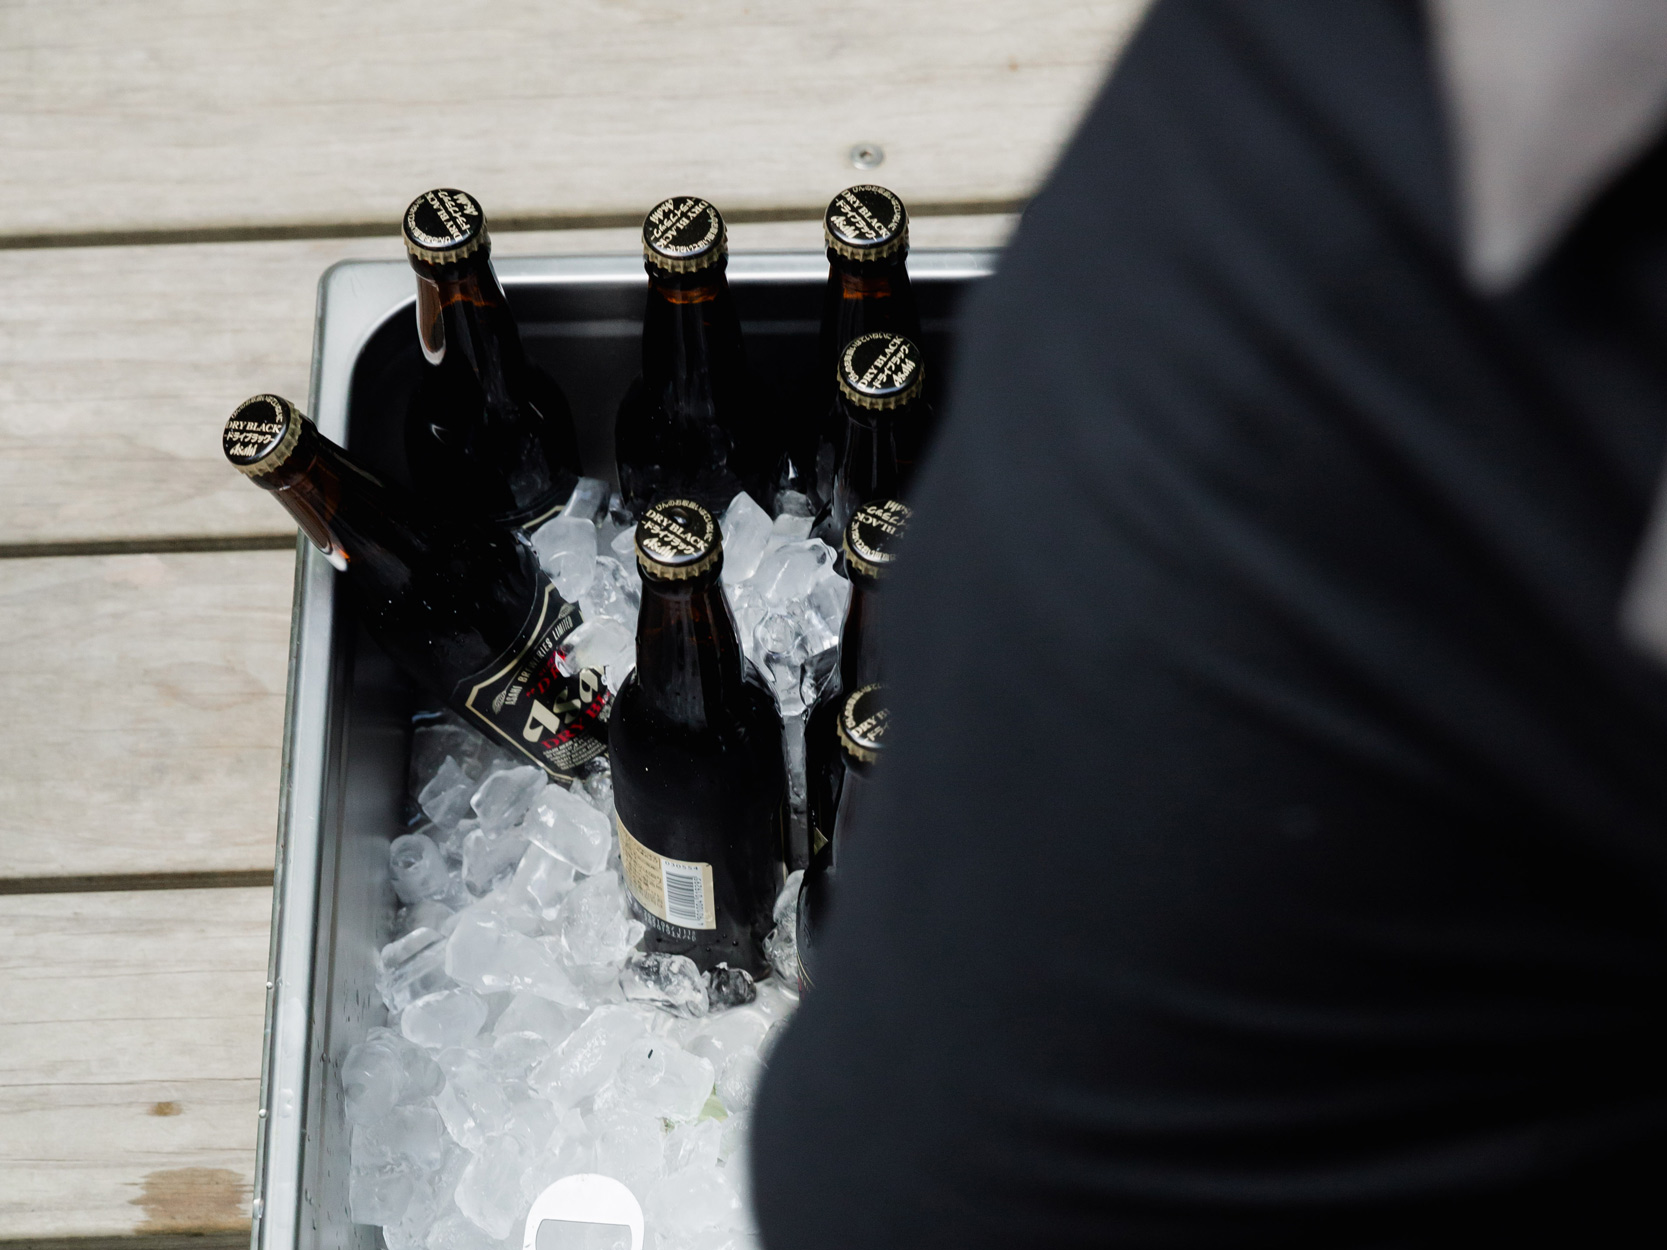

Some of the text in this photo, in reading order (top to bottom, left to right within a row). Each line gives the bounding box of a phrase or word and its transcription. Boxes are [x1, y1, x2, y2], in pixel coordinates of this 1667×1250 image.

[424, 191, 464, 242] DRY BLACK
[649, 199, 674, 225] Asahi
[656, 200, 709, 249] DRY BLACK
[841, 189, 891, 239] DRY BLACK
[831, 215, 859, 239] Asahi
[857, 336, 904, 389] DRY BLACK
[892, 358, 916, 388] Asahi
[225, 420, 283, 434] DRY BLACK
[229, 442, 258, 458] Asahi
[645, 509, 709, 553] DRY BLACK
[854, 511, 897, 536] BLACK
[643, 537, 677, 559] Asahi
[552, 615, 573, 641] LIMITED
[541, 717, 584, 750] DRY
[850, 715, 877, 738] DRY
